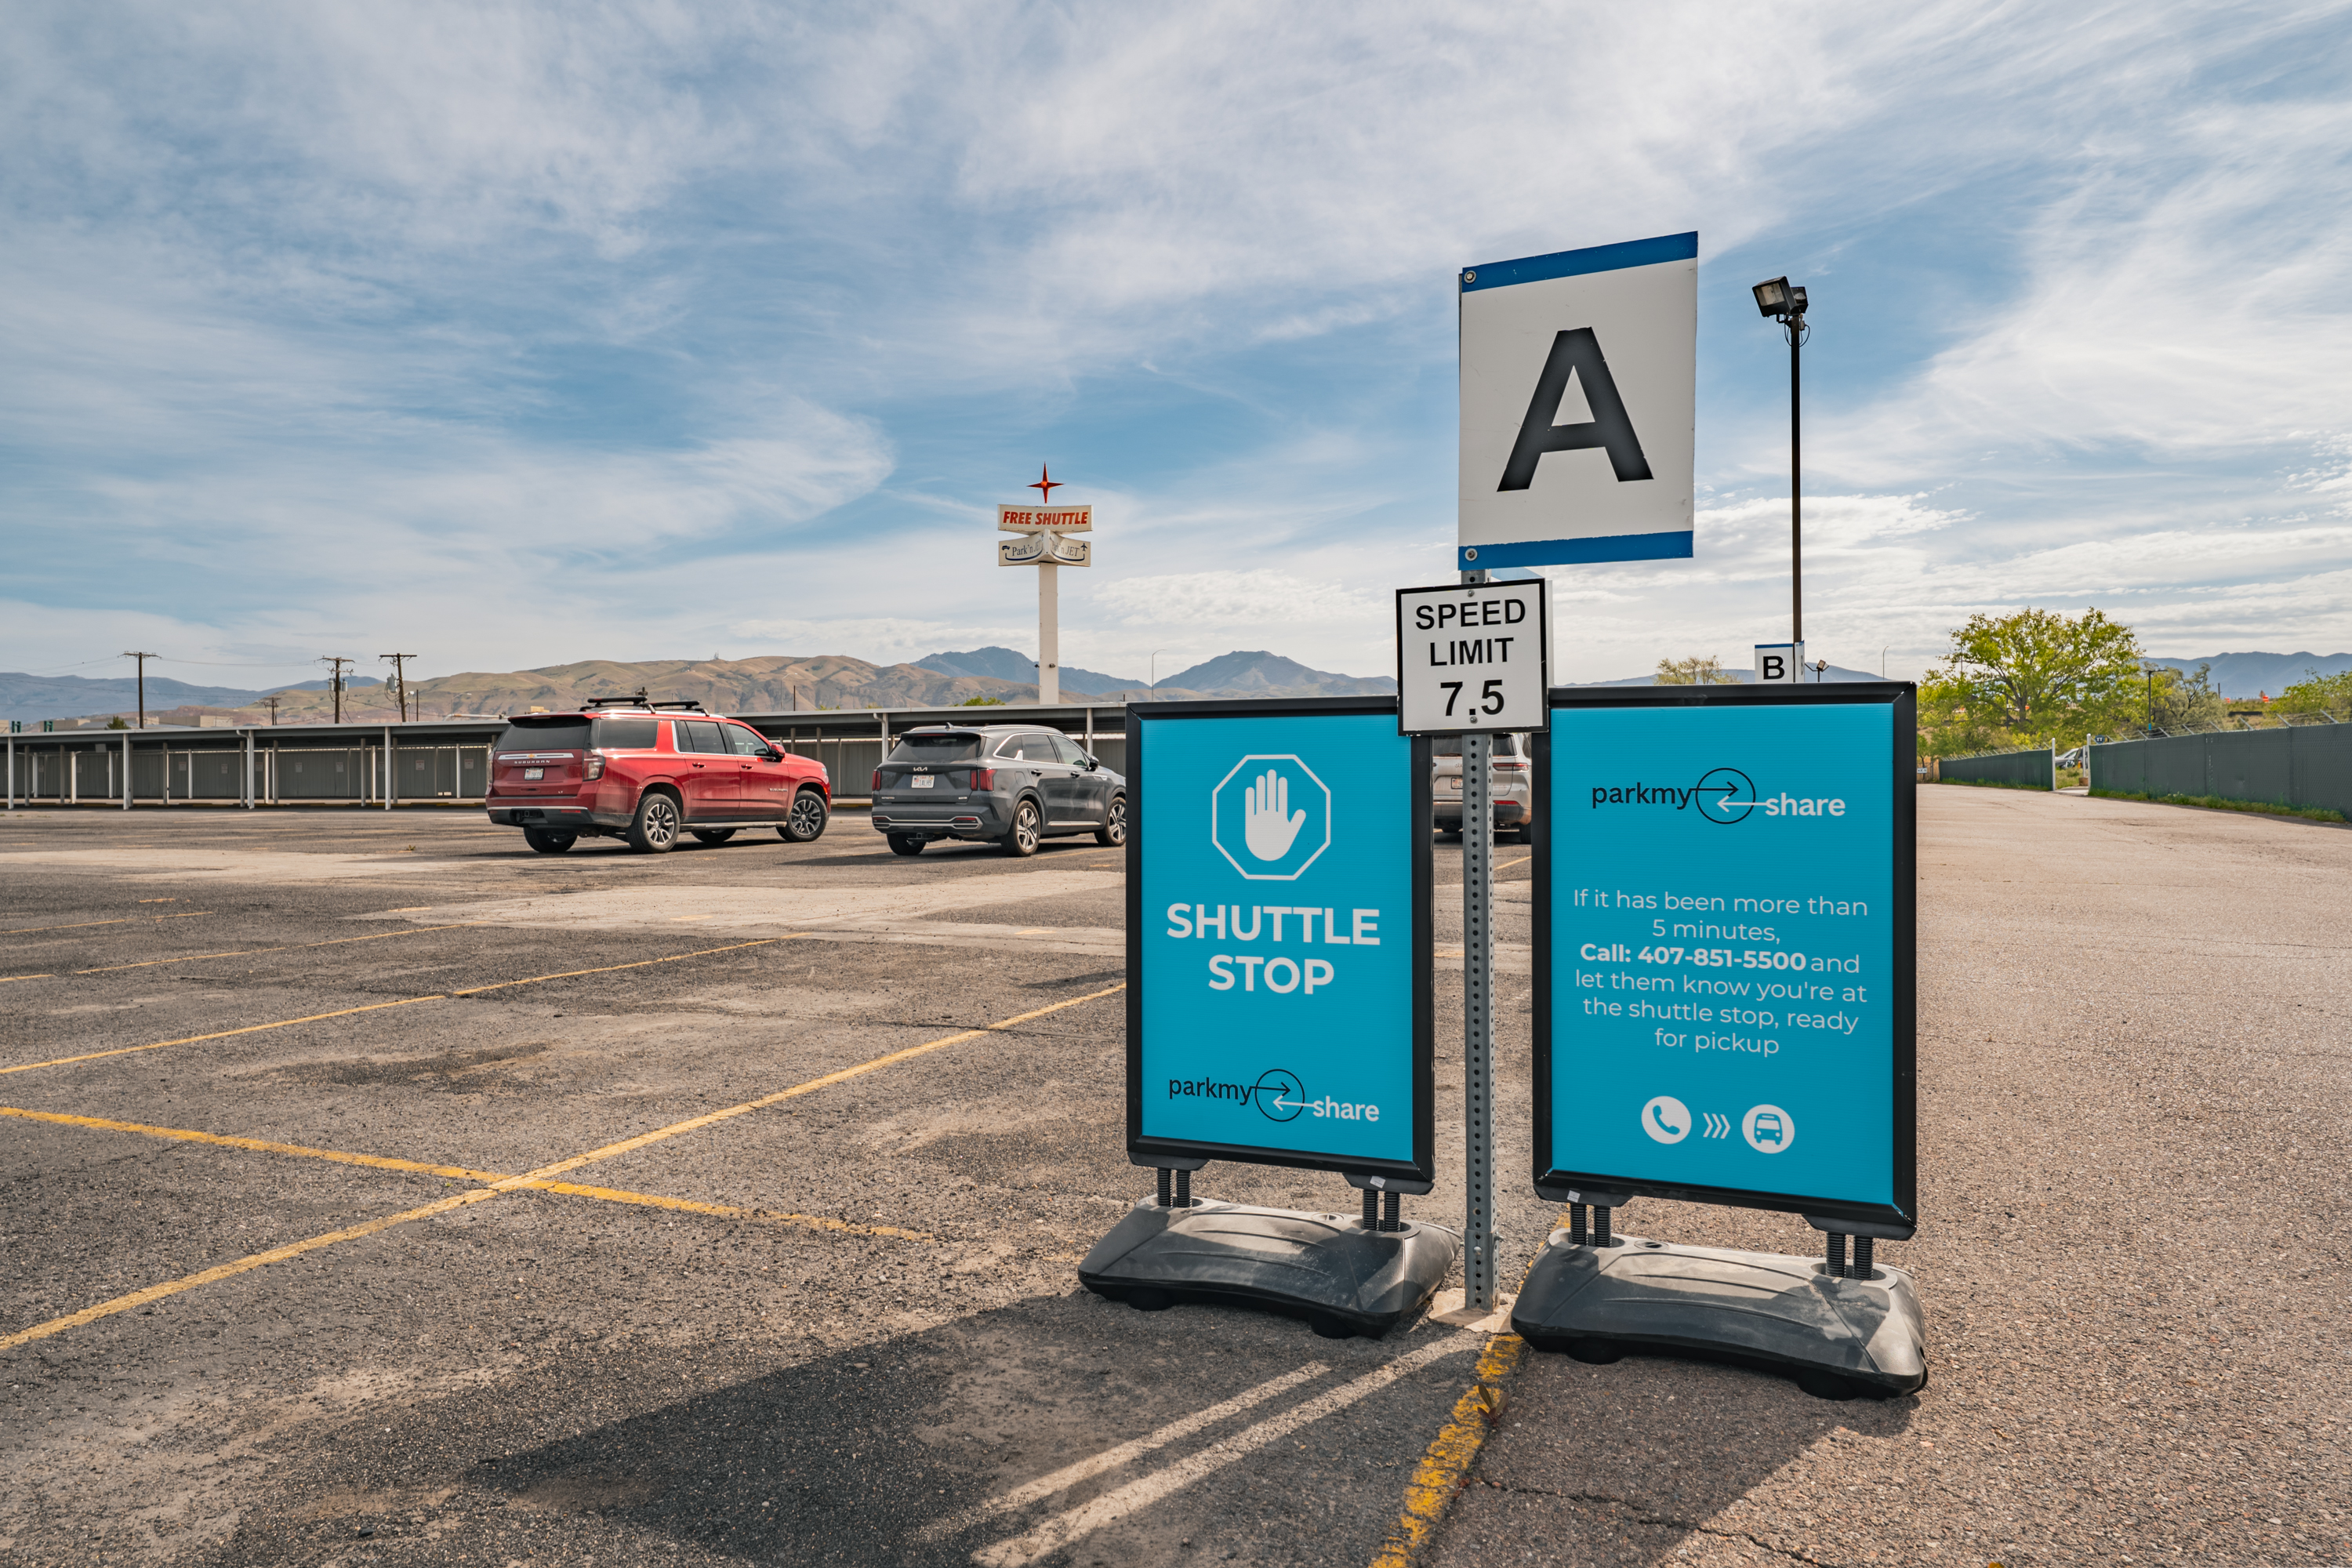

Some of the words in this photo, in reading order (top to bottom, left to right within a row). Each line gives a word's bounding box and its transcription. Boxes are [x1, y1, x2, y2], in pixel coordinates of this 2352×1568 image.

[1497, 326, 1654, 492] A
[1003, 511, 1032, 524] FREE
[1035, 512, 1088, 525] SHUTTLE
[1065, 546, 1080, 557] JET
[1415, 598, 1526, 630] SPEED
[1430, 637, 1514, 666] LIMIT
[1762, 655, 1785, 681] B
[1440, 679, 1504, 717] 7.5
[1592, 782, 1692, 811] parkmy
[1765, 792, 1846, 817] share
[1574, 889, 1588, 906] If
[1595, 889, 1609, 907] it
[1617, 890, 1657, 909] has
[1664, 891, 1725, 911] been
[1734, 898, 1800, 914] more
[1807, 895, 1867, 916] than
[1167, 902, 1381, 946] SHUTTLE
[1653, 919, 1666, 937] 5
[1674, 920, 1780, 945] minutes,
[1580, 943, 1631, 963] Call:
[1638, 946, 1806, 971] 407-851-5500
[1810, 954, 1860, 973] and
[1208, 954, 1334, 995] STOP
[1576, 969, 1604, 989] let
[1610, 971, 1675, 992] them
[1683, 975, 1751, 996] know
[1756, 982, 1834, 1001] you're
[1842, 985, 1867, 1003] at
[1583, 996, 1622, 1016] the
[1628, 1000, 1713, 1022] shuttle
[1720, 1007, 1779, 1029] stop,
[1788, 1011, 1859, 1035] ready
[1654, 1028, 1687, 1047] for
[1695, 1031, 1780, 1058] pickup
[1169, 1076, 1253, 1105] parkmy
[1312, 1095, 1380, 1122] share
